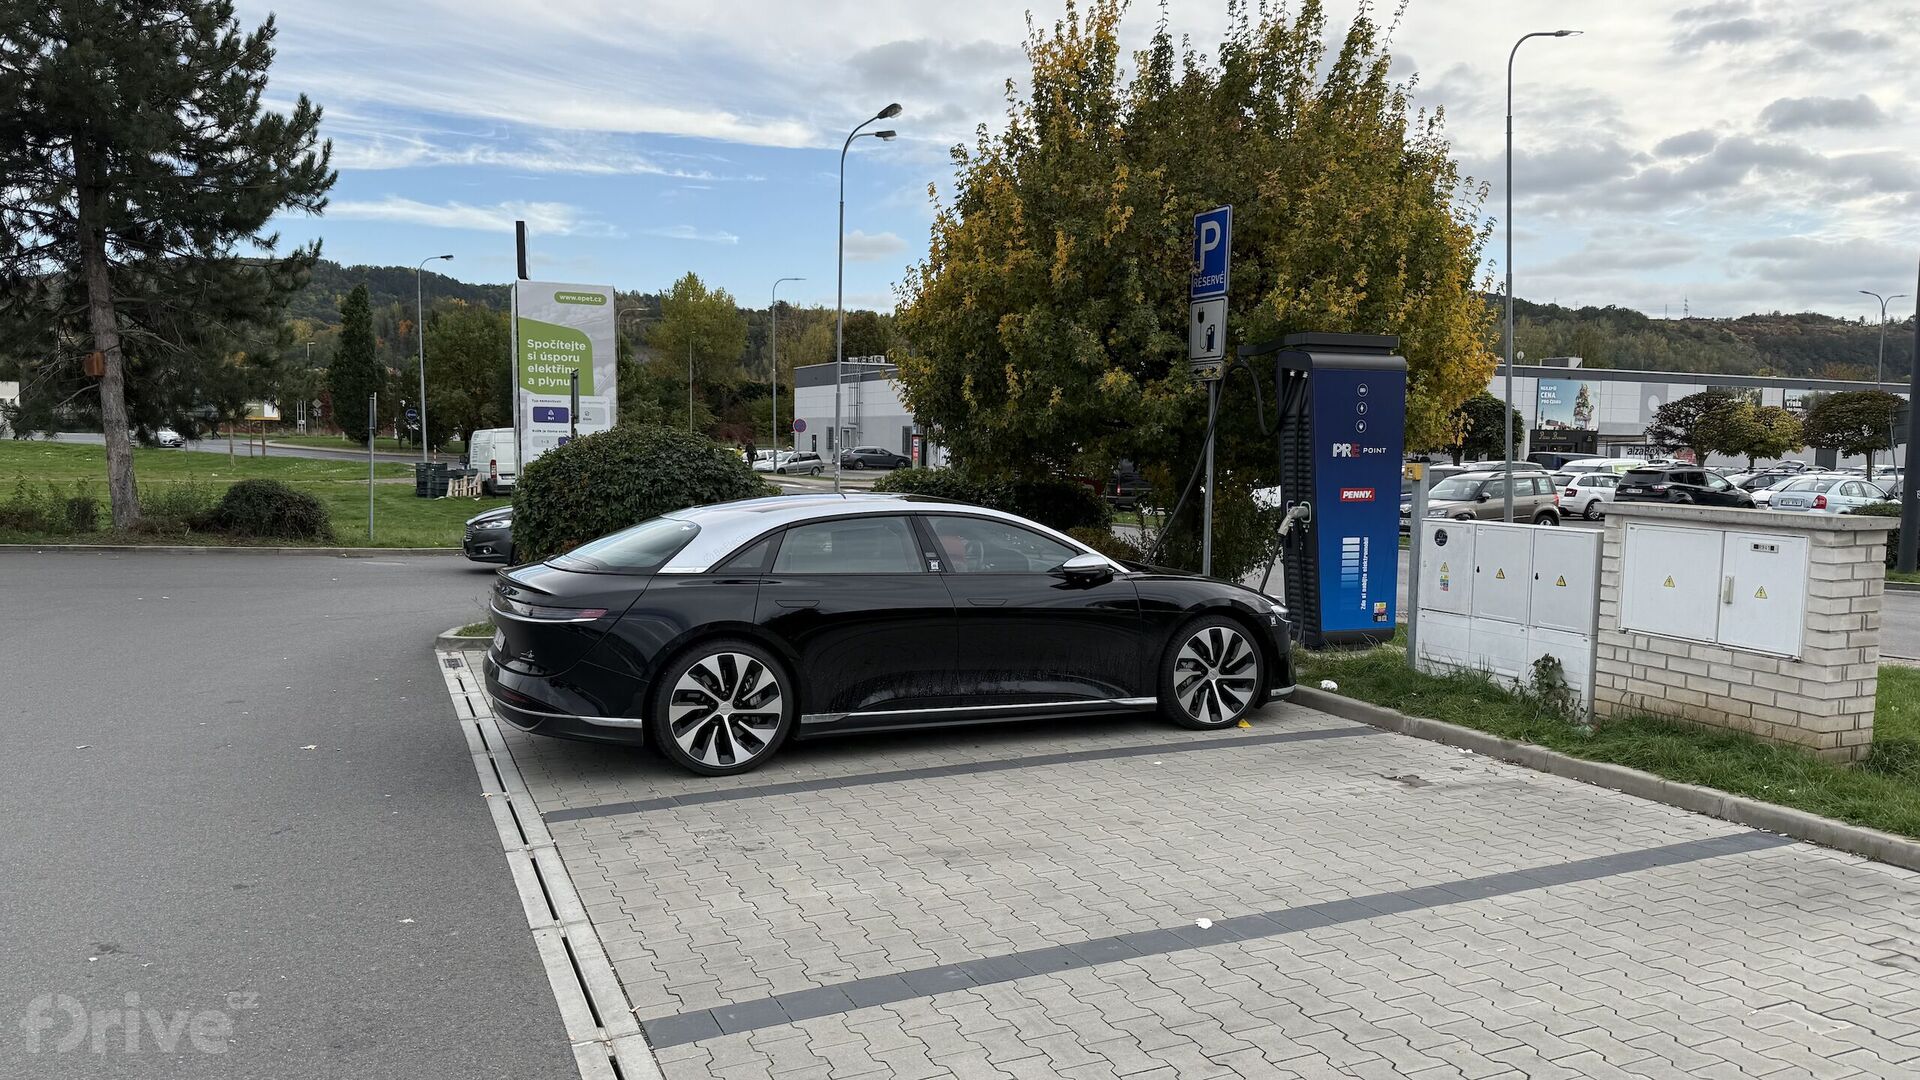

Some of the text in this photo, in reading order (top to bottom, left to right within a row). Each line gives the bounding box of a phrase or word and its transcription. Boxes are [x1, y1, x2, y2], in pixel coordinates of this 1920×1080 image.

[1200, 220, 1221, 272] P
[559, 294, 602, 303] www.epet.cz
[527, 338, 587, 352] Spočítejte
[527, 351, 580, 363] si úsporu
[527, 376, 571, 387] a plynu
[1540, 391, 1556, 399] CENA
[1332, 443, 1360, 458] PRE
